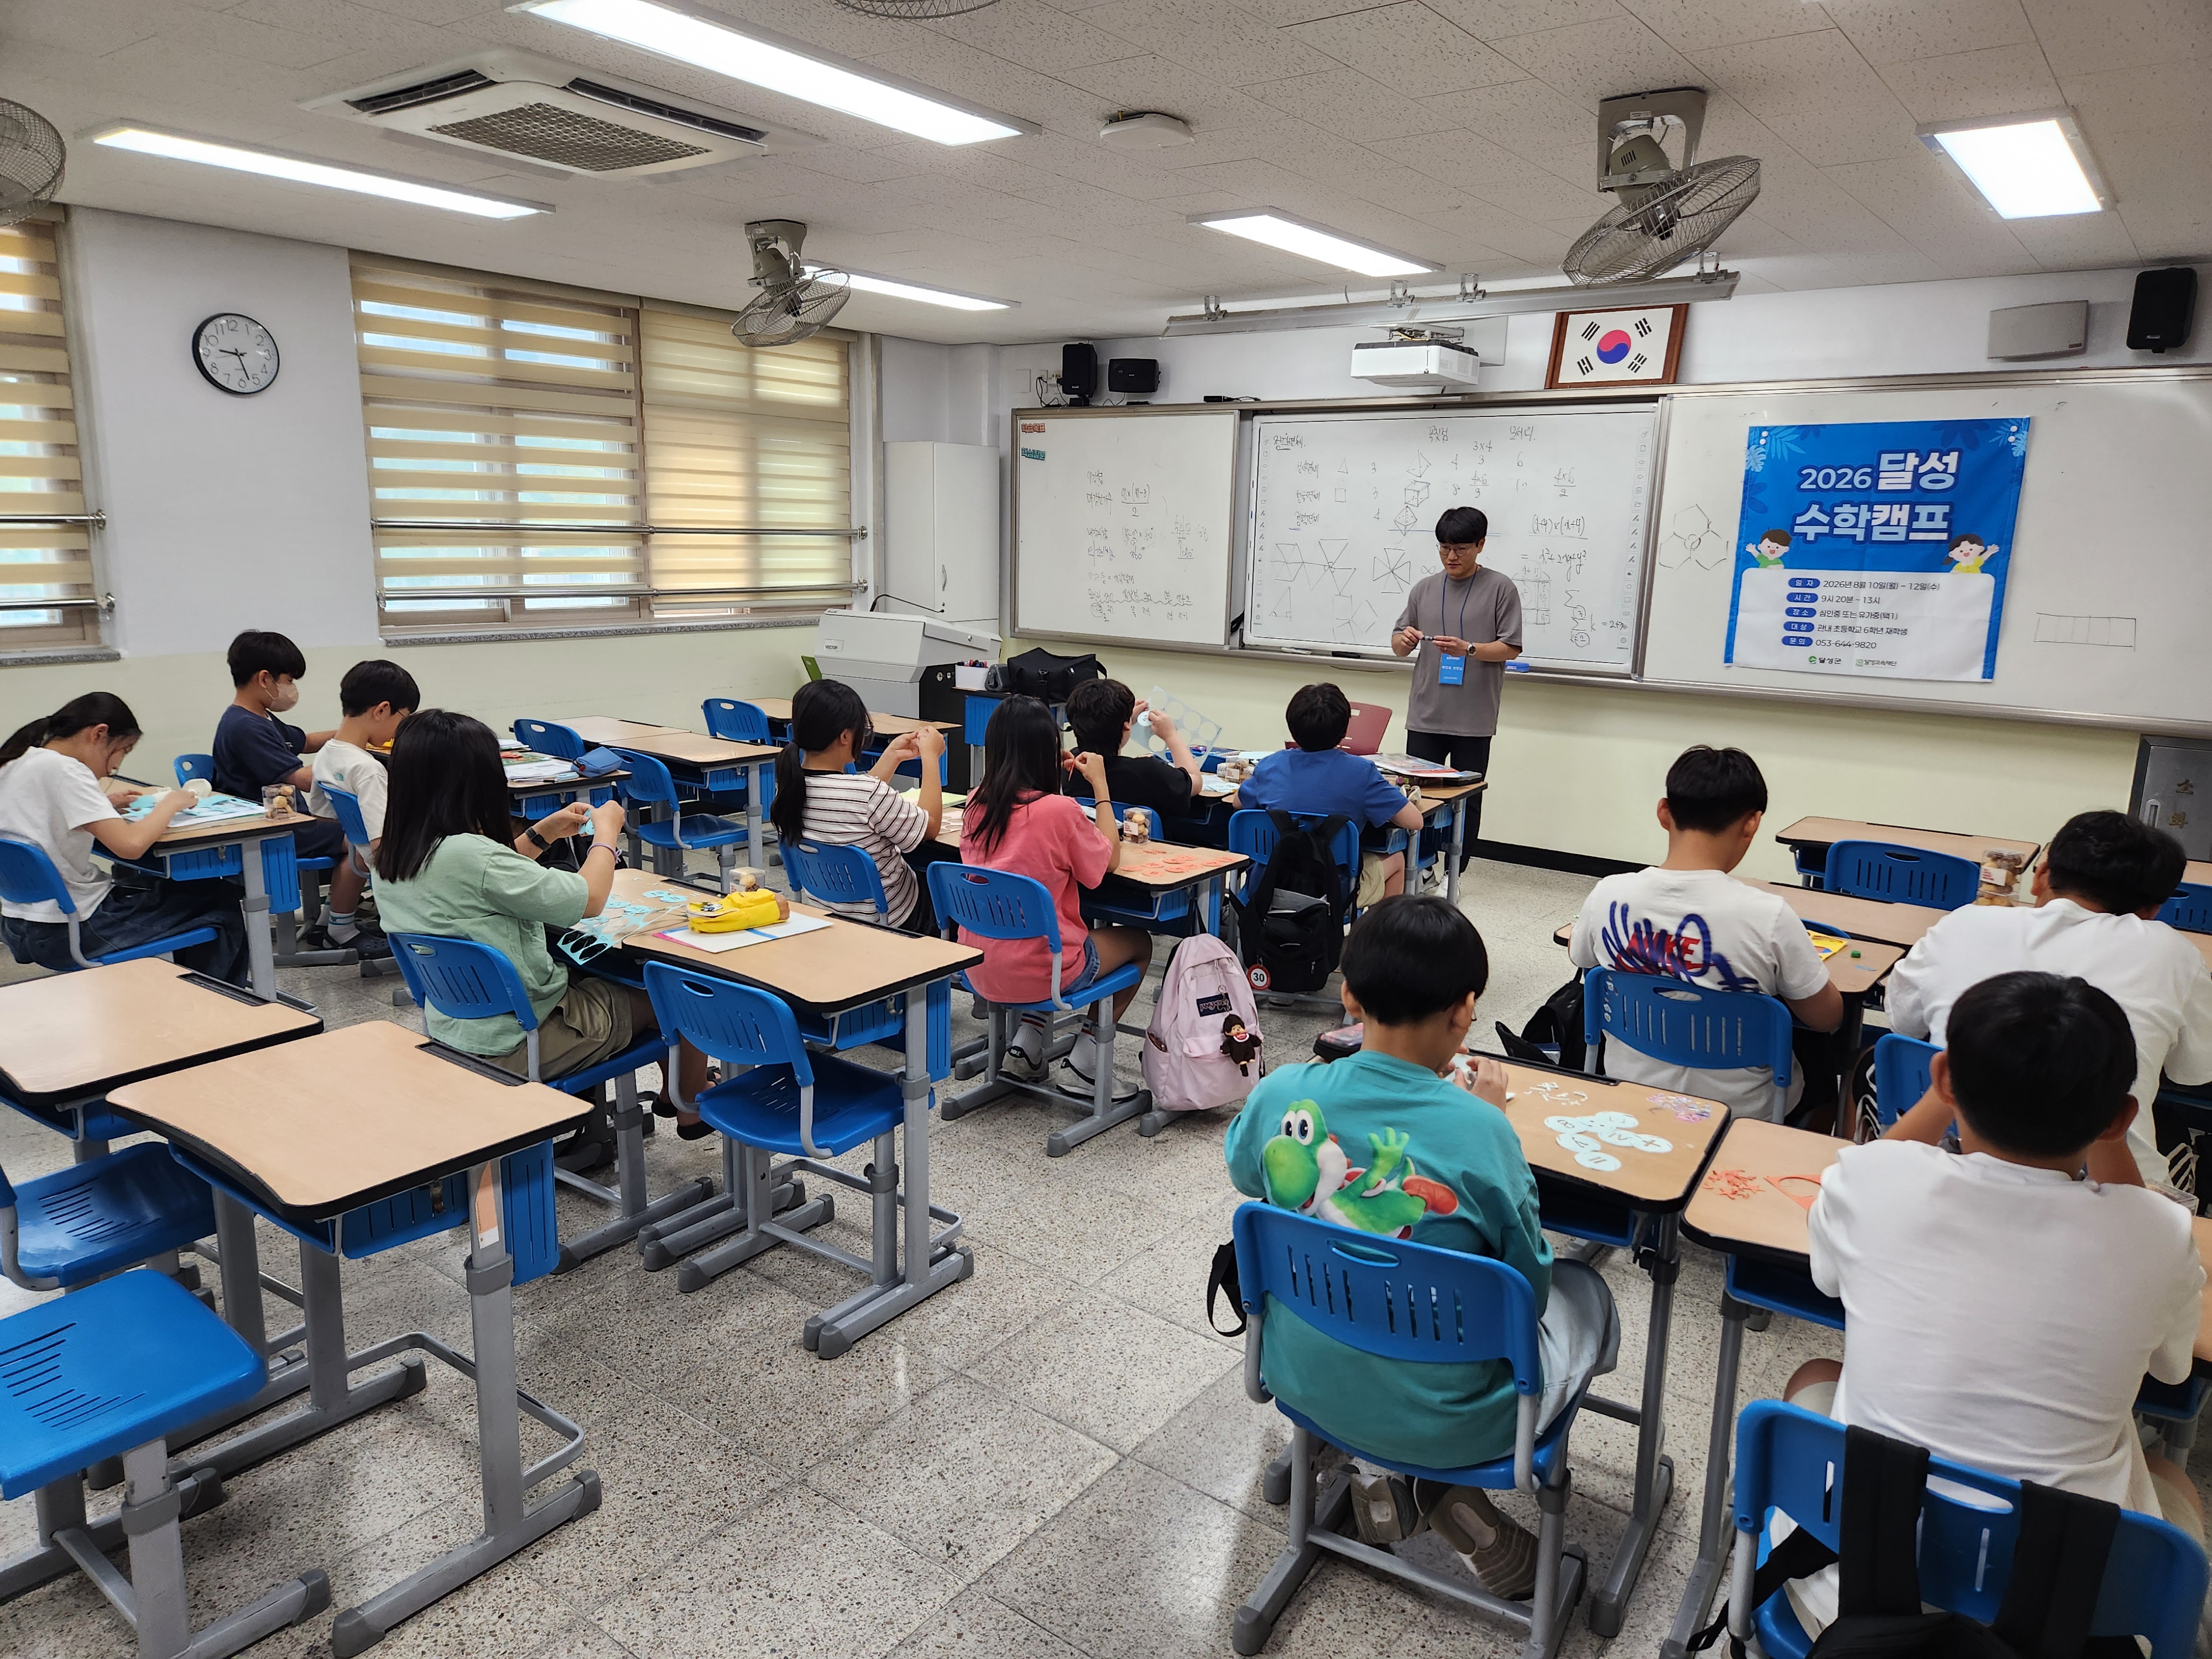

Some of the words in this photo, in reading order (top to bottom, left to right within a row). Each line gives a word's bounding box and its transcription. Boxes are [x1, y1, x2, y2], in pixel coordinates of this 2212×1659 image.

[215, 324, 225, 335] 11
[226, 320, 238, 332] 12
[245, 324, 249, 335] 1
[204, 335, 219, 346] 10
[255, 335, 264, 346] 2
[264, 349, 272, 361] 3
[211, 362, 218, 374] 8
[261, 363, 268, 374] 4
[223, 373, 230, 384] 7
[238, 377, 247, 389] 6
[252, 374, 260, 385] 5
[1021, 423, 1046, 433] 학습목표
[1021, 447, 1045, 461] 핵심질문
[1371, 462, 1376, 474] 3
[1451, 453, 1459, 470] 4
[1517, 451, 1524, 467] 6
[1478, 455, 1484, 465] 3
[1800, 468, 1873, 489] 2026
[1877, 451, 1959, 490] 달성
[1559, 488, 1569, 497] 2
[1793, 504, 1950, 541] 수학캠프
[1869, 582, 1898, 590] 10일(월)
[1859, 612, 1898, 620] 유가중(택1)
[1815, 639, 1877, 649] 053-644-9820
[1253, 972, 1265, 982] 30
